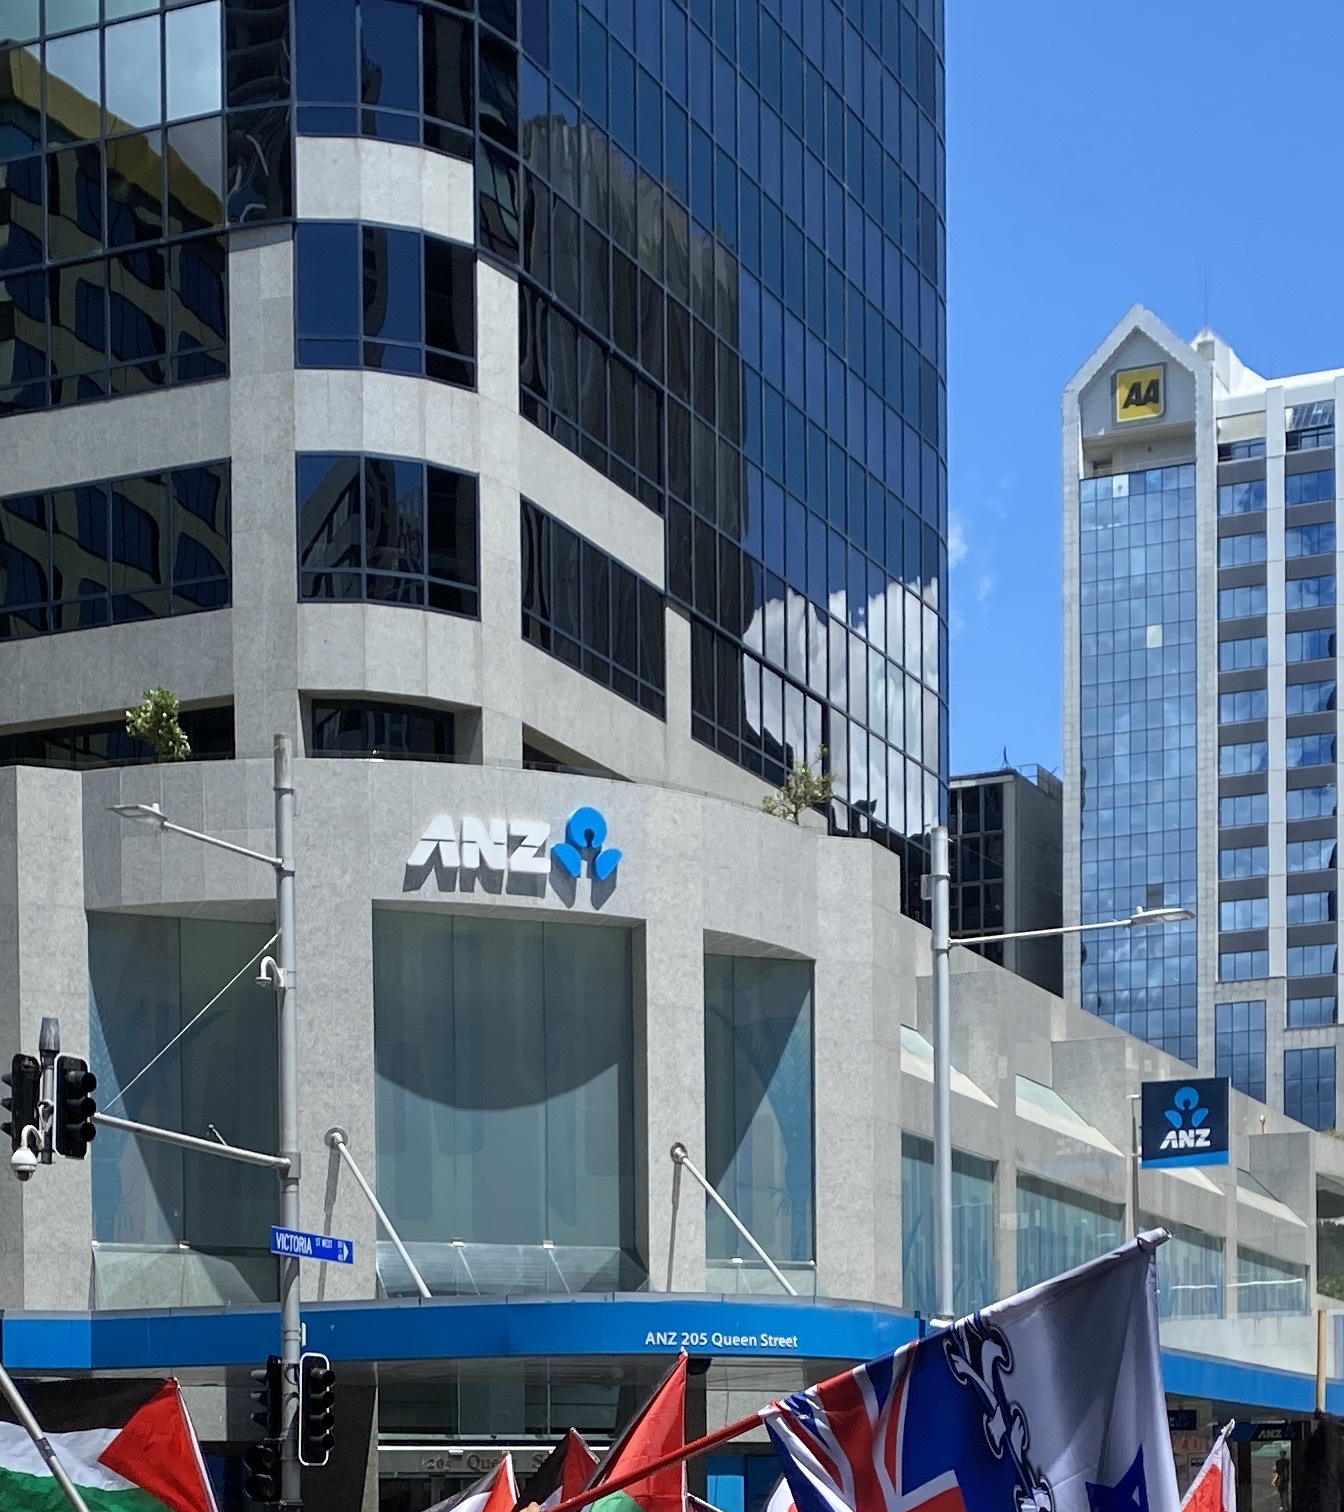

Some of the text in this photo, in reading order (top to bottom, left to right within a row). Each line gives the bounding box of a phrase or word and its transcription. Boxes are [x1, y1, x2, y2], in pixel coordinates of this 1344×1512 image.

[1122, 379, 1160, 409] AA
[407, 814, 552, 874] ANZ
[1160, 1128, 1211, 1149] ANZ
[275, 1232, 313, 1255] VICTORIA
[645, 1332, 798, 1348] ANZ 205 Queen Street
[1257, 1429, 1283, 1439] ANZ
